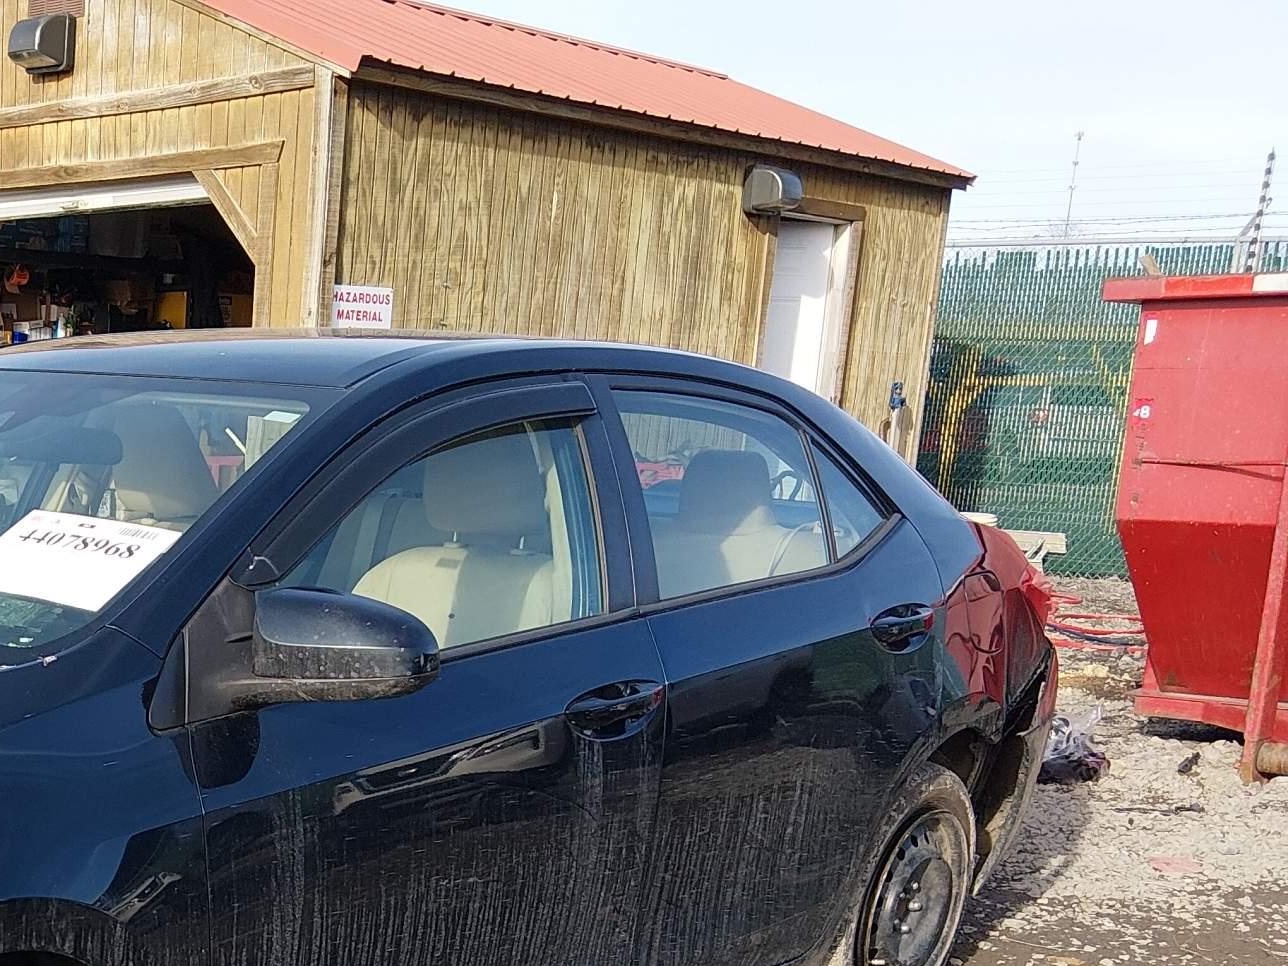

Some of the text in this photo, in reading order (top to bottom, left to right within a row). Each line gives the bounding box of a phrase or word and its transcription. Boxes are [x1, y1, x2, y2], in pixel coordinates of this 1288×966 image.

[333, 291, 391, 305] HAZARDOUS
[336, 309, 383, 322] MATERIAL
[19, 529, 141, 559] 44078968
